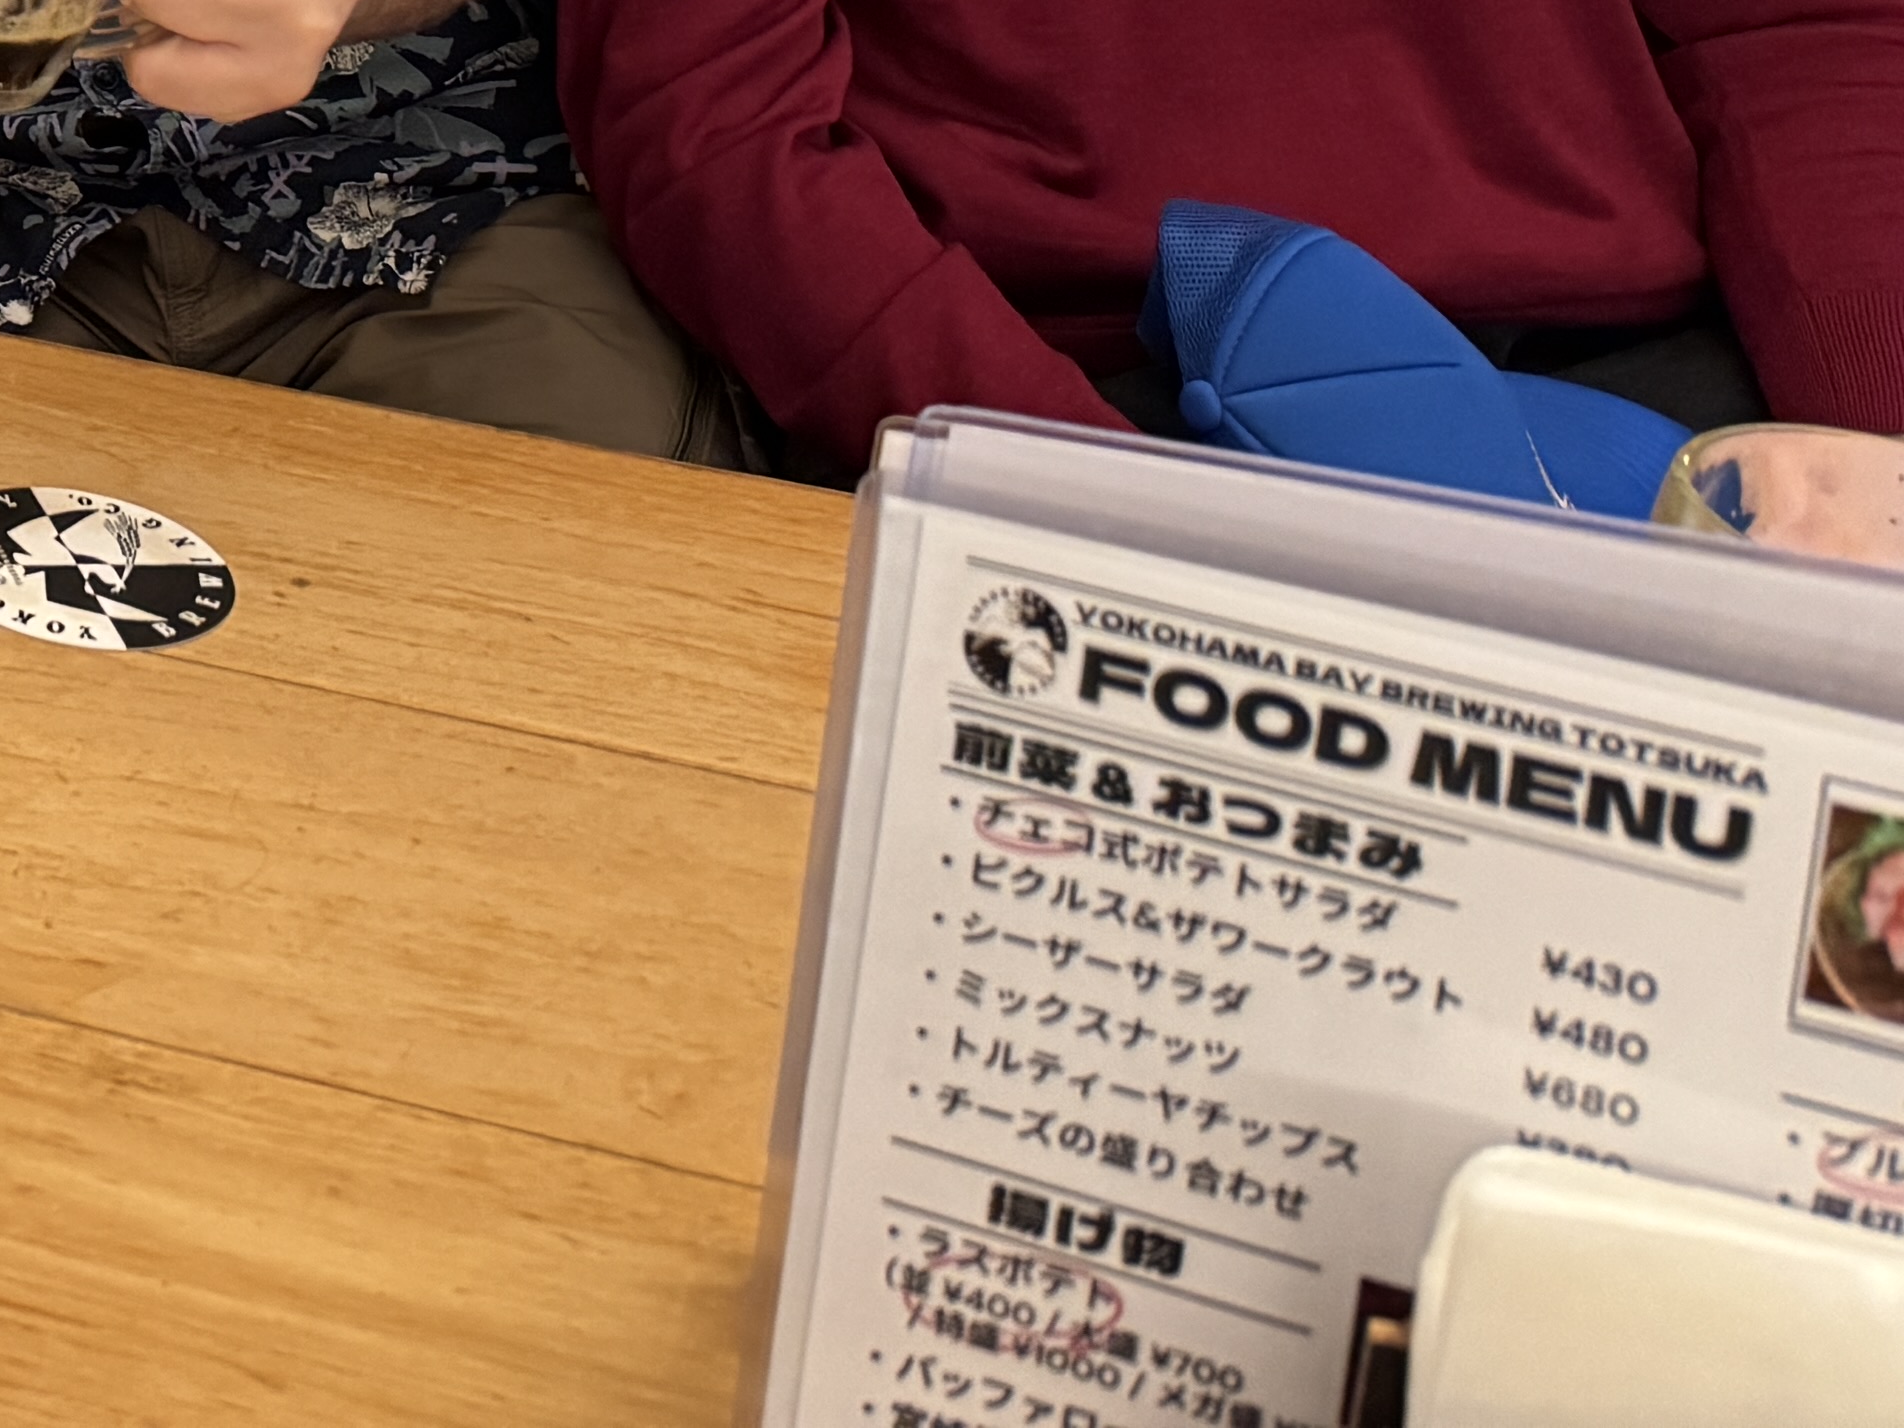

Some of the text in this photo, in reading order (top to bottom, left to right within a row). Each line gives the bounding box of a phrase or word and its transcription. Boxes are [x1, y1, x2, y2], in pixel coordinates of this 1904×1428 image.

[140, 518, 224, 639] BREWING
[1074, 599, 1289, 676] YOKOHAMA
[1291, 654, 1377, 698] BAY
[1378, 676, 1565, 744] BREWING
[1571, 724, 1770, 795] TOTSUKA
[1077, 643, 1754, 864] FOOD MENU
[1541, 945, 1659, 1006] ¥430
[1532, 1005, 1650, 1066] ¥480
[1523, 1065, 1641, 1128] ¥680
[942, 1277, 1038, 1329] ¥400
